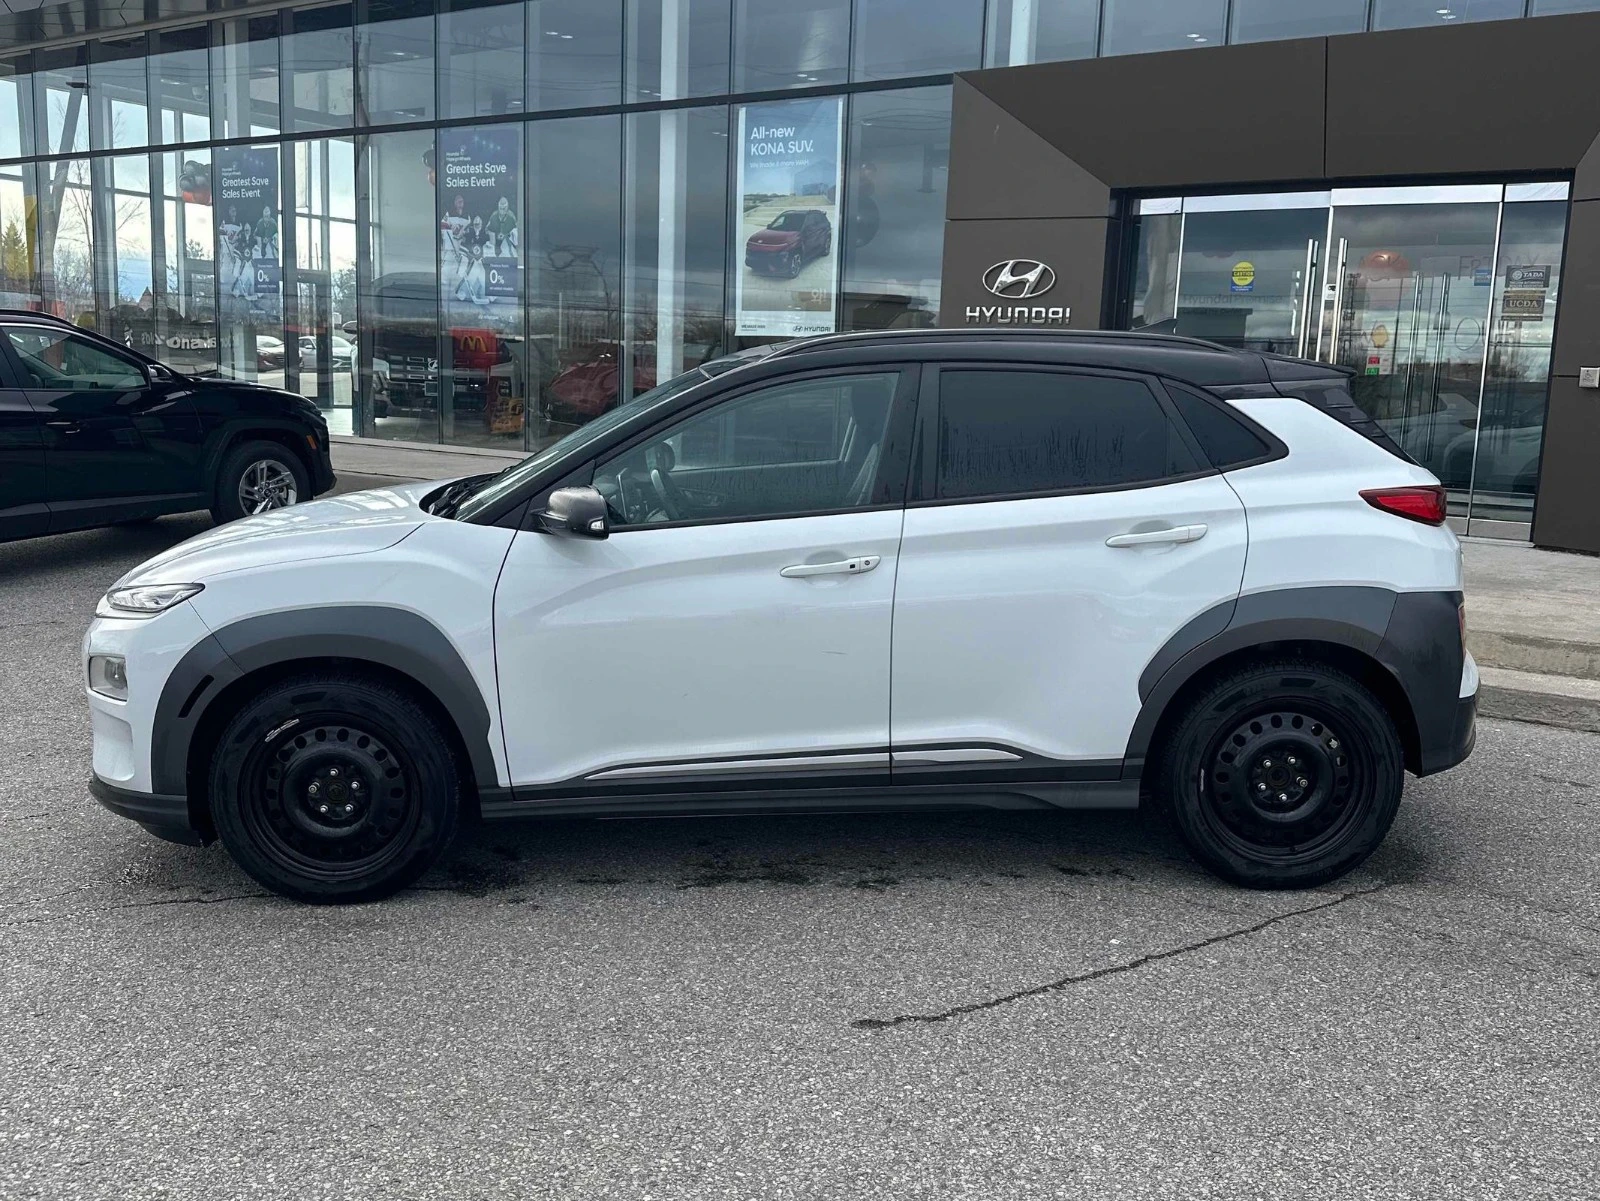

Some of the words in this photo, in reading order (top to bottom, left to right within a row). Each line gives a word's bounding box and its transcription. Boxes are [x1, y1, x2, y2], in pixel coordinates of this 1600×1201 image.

[750, 126, 796, 140] All-new
[750, 141, 786, 156] KONA
[787, 139, 814, 154] SUV.
[445, 163, 483, 174] Greatest
[484, 162, 507, 173] Save
[222, 177, 251, 188] Greatest
[251, 176, 269, 186] Save
[445, 177, 469, 188] Sales
[470, 176, 496, 187] Event
[222, 189, 241, 199] Sales
[241, 188, 261, 198] Event
[257, 269, 270, 282] 0%
[489, 269, 505, 284] 0%
[1509, 300, 1539, 308] UCDA
[965, 306, 1071, 324] HYUNDAI
